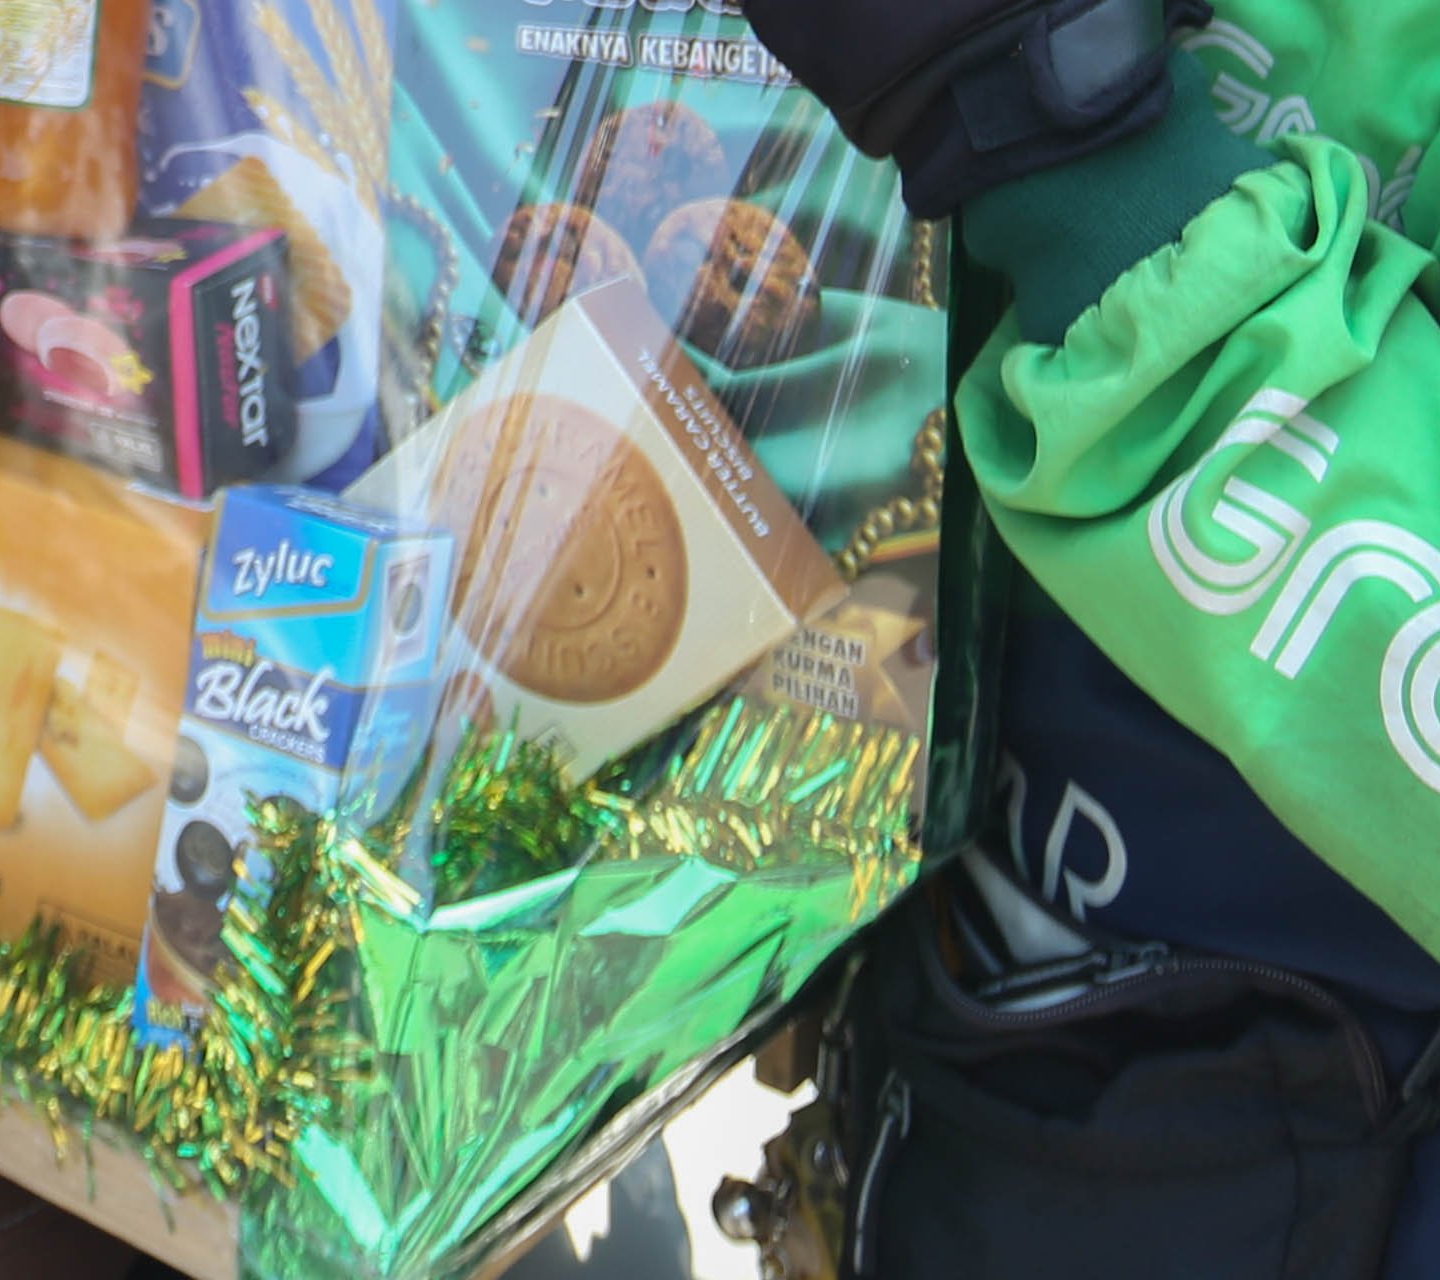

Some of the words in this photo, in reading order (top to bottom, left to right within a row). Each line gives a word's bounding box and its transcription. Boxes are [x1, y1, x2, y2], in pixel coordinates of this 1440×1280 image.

[521, 27, 629, 62] ENAKNYA
[640, 36, 793, 82] KEBANGET
[638, 346, 712, 451] CARAMEL
[684, 384, 754, 482] BISCUITS
[707, 448, 770, 539] BUTTER
[233, 540, 334, 598] Zyluc
[193, 658, 335, 742] Black
[773, 647, 852, 687] KURMA
